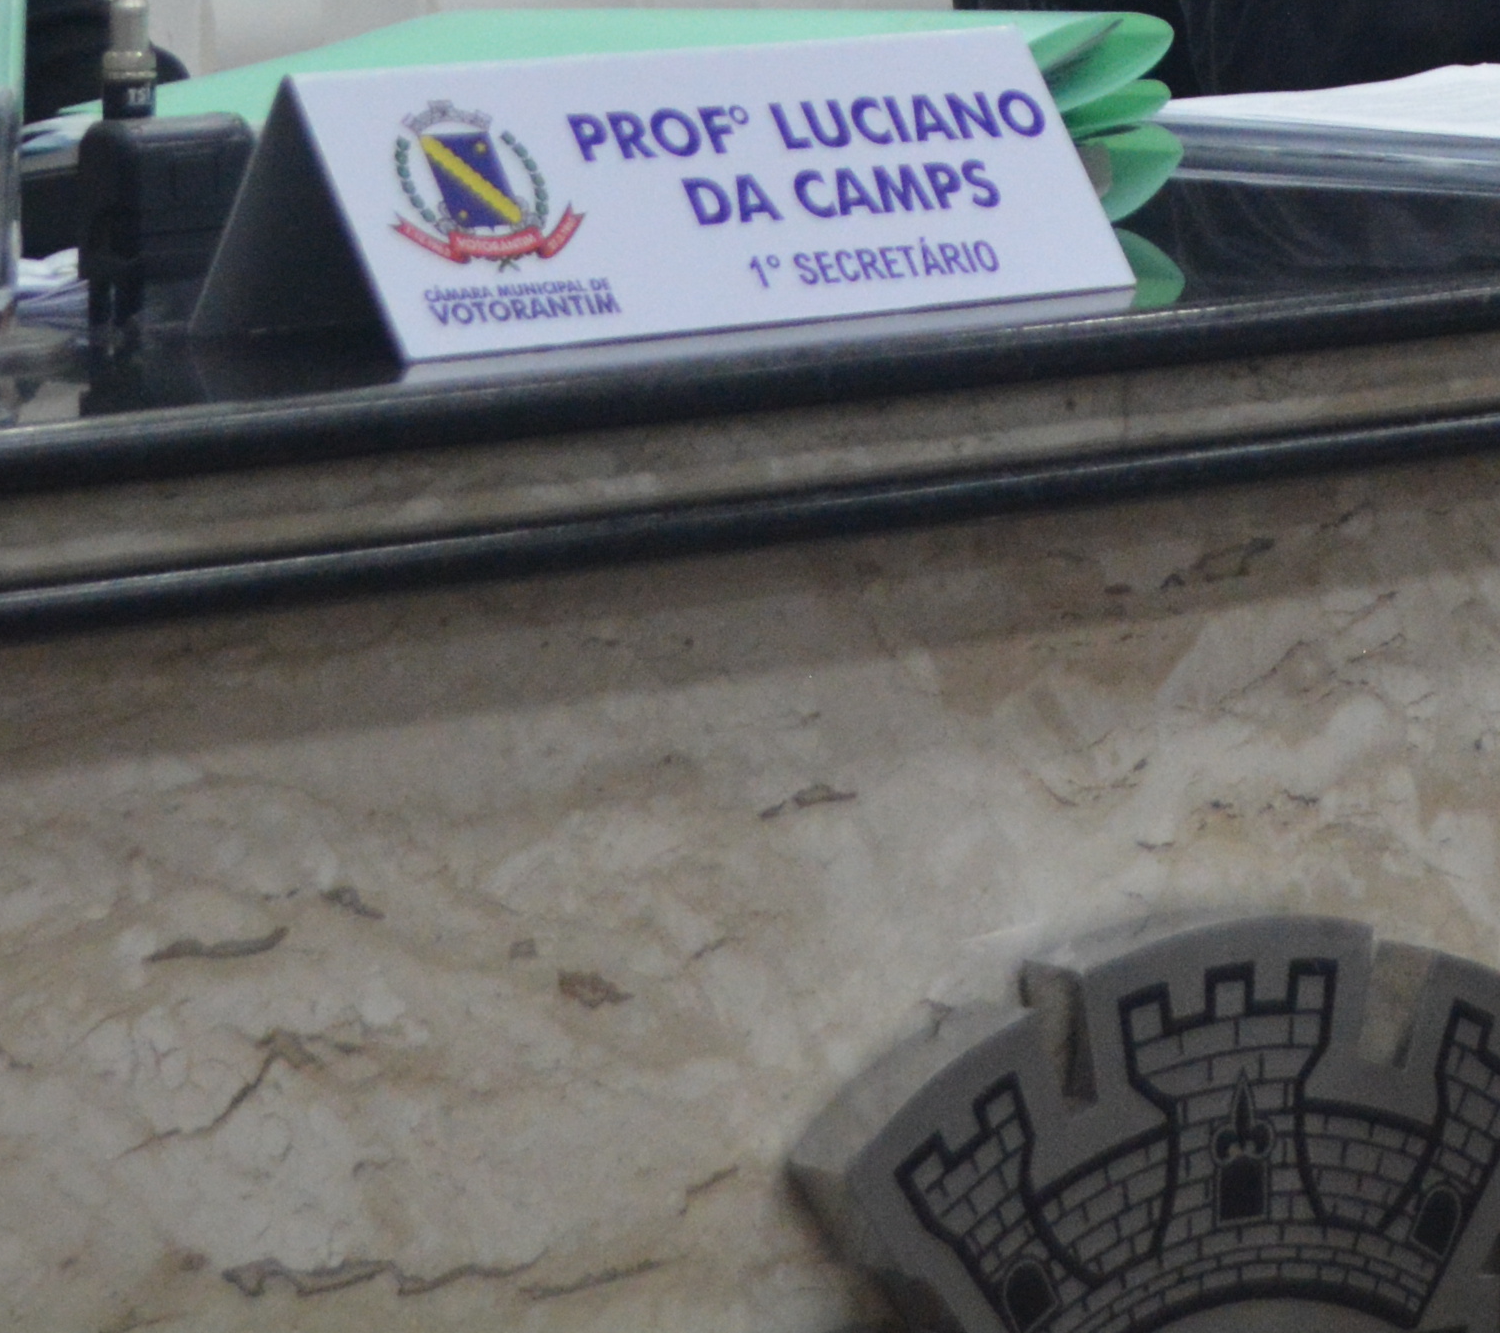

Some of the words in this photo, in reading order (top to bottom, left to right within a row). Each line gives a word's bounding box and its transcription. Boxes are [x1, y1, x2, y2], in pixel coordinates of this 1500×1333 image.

[767, 87, 1047, 151] LUCIANO
[680, 172, 784, 228] DA
[791, 158, 1002, 223] CAMPS
[793, 231, 1001, 288] SECRETÁRIO
[424, 283, 493, 303] CÂMARA
[496, 278, 587, 299] MUNICIPAL
[589, 276, 612, 292] DE
[428, 292, 622, 326] VOTORANTIM
